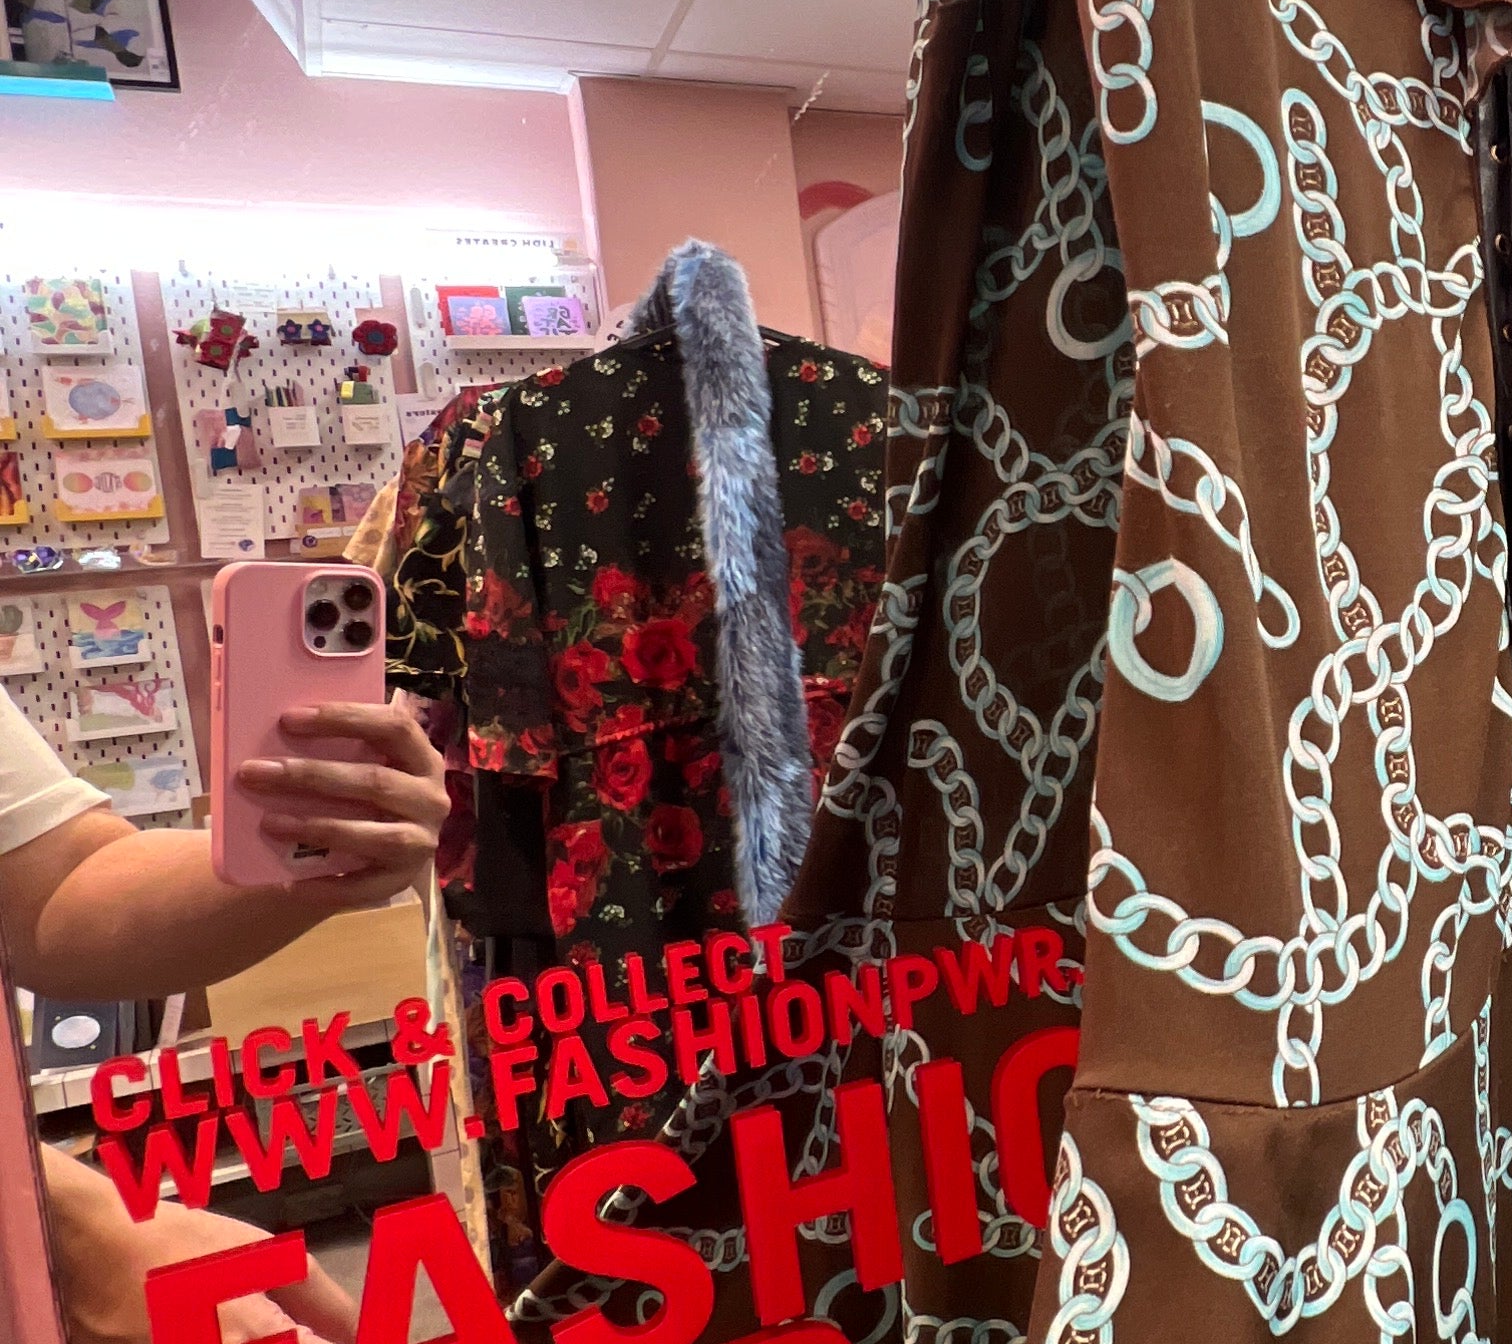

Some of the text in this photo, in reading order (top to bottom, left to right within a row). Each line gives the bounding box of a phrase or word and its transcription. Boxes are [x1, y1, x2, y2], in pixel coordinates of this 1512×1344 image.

[90, 923, 792, 1133] CLICK & COLLECT
